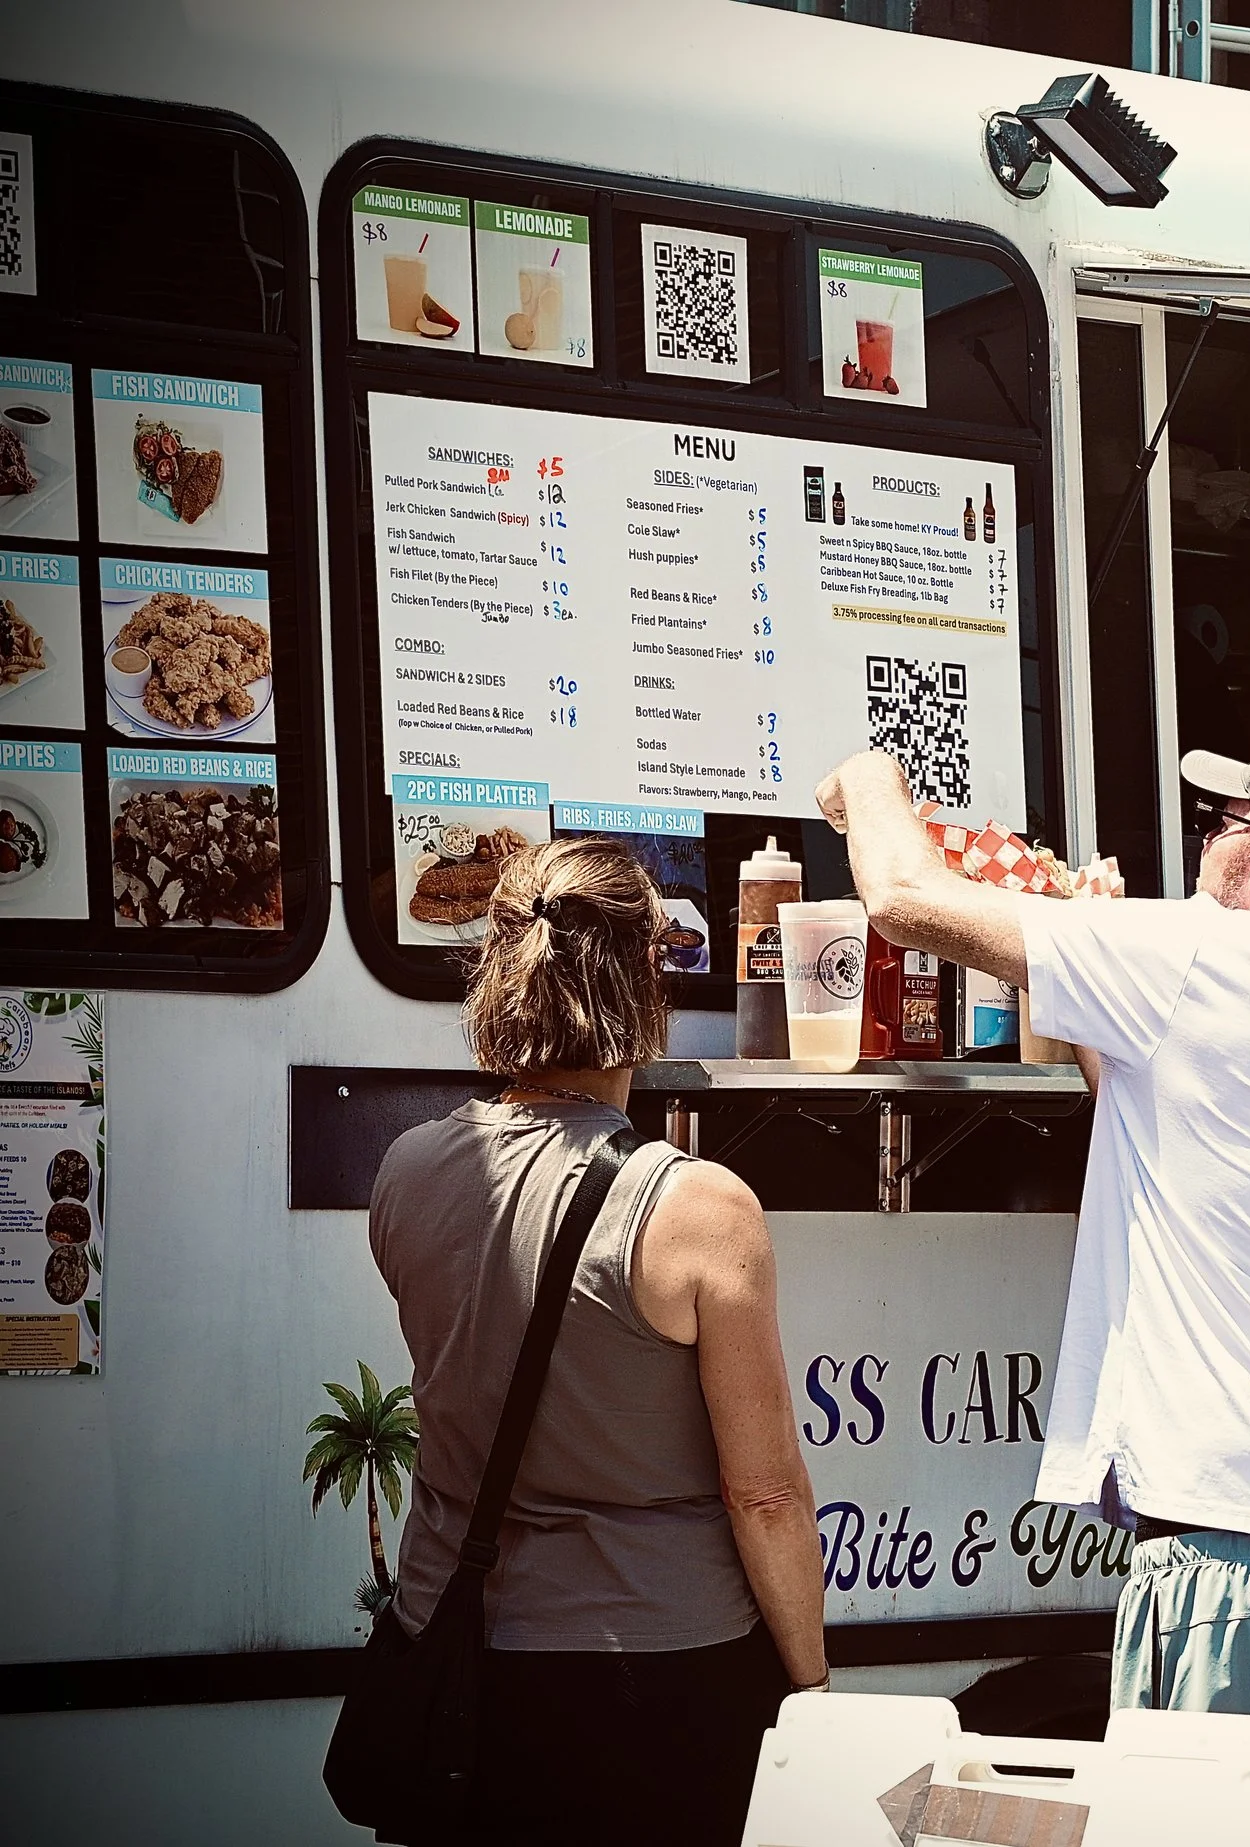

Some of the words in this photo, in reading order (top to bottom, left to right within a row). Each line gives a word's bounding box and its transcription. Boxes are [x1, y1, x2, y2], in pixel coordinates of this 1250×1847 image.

[365, 192, 402, 210] MANGO
[406, 197, 461, 218] LEMONADE
[362, 221, 387, 245] $8
[495, 209, 573, 238] LEMONADE
[822, 256, 875, 274] STRAWBERRY
[878, 264, 919, 280] LEMONADE
[827, 280, 847, 298] $8
[112, 375, 149, 397] FISH
[153, 380, 239, 407] SANDWICH
[428, 447, 514, 467] SANDWICHES:
[674, 434, 735, 461] MENU
[537, 457, 564, 479] $5
[385, 475, 415, 488] Pulled
[417, 478, 438, 490] Pork
[440, 480, 486, 494] Sandwich
[654, 470, 694, 488] SIDES:
[872, 476, 940, 497] PRODUCTS:
[386, 501, 405, 514] Jerk
[407, 503, 446, 517] Chicken
[450, 507, 496, 522] Sandwich
[498, 512, 529, 527] (Spicy)
[626, 498, 673, 512] Seasoned
[387, 528, 407, 540] Fish
[409, 530, 455, 544] Sandwich
[628, 524, 650, 535] Cole
[851, 516, 869, 526] Take
[871, 520, 893, 529] some
[894, 521, 920, 532] home!
[922, 525, 932, 534] KY
[933, 526, 959, 537] Proud!
[389, 544, 401, 555] w/
[403, 545, 439, 560] lettuce,
[441, 549, 478, 562] tomato,
[480, 551, 507, 564] Tartar
[509, 555, 537, 566] Sauce
[628, 549, 654, 561] Hush
[820, 535, 844, 547] Sweet
[853, 539, 874, 551] Spicy
[876, 541, 892, 553] BBQ
[894, 544, 920, 556] Sauce,
[922, 547, 942, 557] 18oz.
[944, 549, 967, 560] bottle
[11, 555, 60, 580] FRIES
[820, 551, 852, 563] Mustard
[854, 554, 879, 567] Honey
[881, 557, 898, 569] BBQ
[900, 560, 926, 571] Sauce,
[928, 563, 947, 573] 18oz.
[949, 565, 972, 575] bottle
[115, 564, 183, 591] CHICKEN
[186, 568, 253, 594] TENDERS
[390, 568, 409, 580] Fish
[412, 569, 432, 582] Filet
[434, 571, 449, 585] (By
[451, 573, 466, 585] the
[468, 575, 498, 588] Piece)
[820, 566, 861, 578] Caribbean
[863, 570, 877, 580] Hot
[879, 572, 905, 584] Sauce,
[907, 575, 916, 584] 10
[931, 577, 954, 588] Bottle
[630, 588, 648, 599] Red
[651, 589, 680, 602] Beans
[683, 593, 690, 602] &
[821, 581, 848, 592] Deluxe
[850, 584, 867, 594] Fish
[868, 586, 880, 597] Fry
[882, 587, 919, 601] Breading,
[921, 591, 932, 600] 1lb
[934, 592, 948, 604] Bag
[391, 593, 429, 606] Chicken
[431, 596, 468, 609] Tenders
[470, 600, 485, 613] (By
[486, 601, 502, 612] the
[504, 603, 533, 617] Piece)
[631, 614, 655, 626] Fried
[833, 608, 857, 619] 3.75%
[859, 610, 902, 624] processing
[903, 614, 915, 624] fee
[917, 616, 927, 624] on
[928, 616, 938, 626] all
[940, 617, 957, 628] card
[958, 620, 1005, 634] transactions
[395, 638, 445, 655] COMBO:
[633, 641, 664, 654] Jumbo
[667, 644, 714, 658] Seasoned
[396, 668, 455, 683] SANDWICH
[458, 673, 465, 683] &
[468, 674, 473, 684] 2
[475, 674, 505, 687] SIDES
[634, 675, 675, 690] DRINKS:
[398, 700, 435, 714] Loaded
[438, 703, 457, 715] Red
[460, 704, 490, 717] Beans
[493, 708, 500, 718] &
[502, 708, 524, 720] Rice
[635, 706, 670, 719] Bottled
[672, 709, 701, 721] Water
[637, 738, 667, 750] Sodas
[112, 754, 160, 778] LOADED
[163, 756, 187, 778] RED
[190, 756, 228, 779] BEANS
[231, 759, 242, 778] &
[245, 758, 272, 779] RICE
[399, 751, 461, 768] SPECIALS:
[638, 761, 667, 773] Island
[670, 762, 694, 776] Style
[696, 765, 746, 778] Lemonade
[408, 781, 436, 800] 2PC
[440, 783, 471, 802] FISH
[476, 784, 537, 805] PLATTER
[639, 784, 671, 795] Flavors:
[673, 787, 720, 799] Strawberry,
[722, 789, 750, 800] Mango,
[753, 791, 777, 801] Peach
[563, 807, 595, 828] RIBS,
[598, 810, 636, 830] FRIES,
[639, 812, 662, 830] AND
[665, 814, 697, 831] SLAW
[906, 980, 936, 989] KETCHUP
[803, 1354, 889, 1446] SS
[921, 1351, 1046, 1444] CAR
[816, 1501, 936, 1592] Bite
[951, 1509, 996, 1587] &
[1011, 1499, 1133, 1588] You
